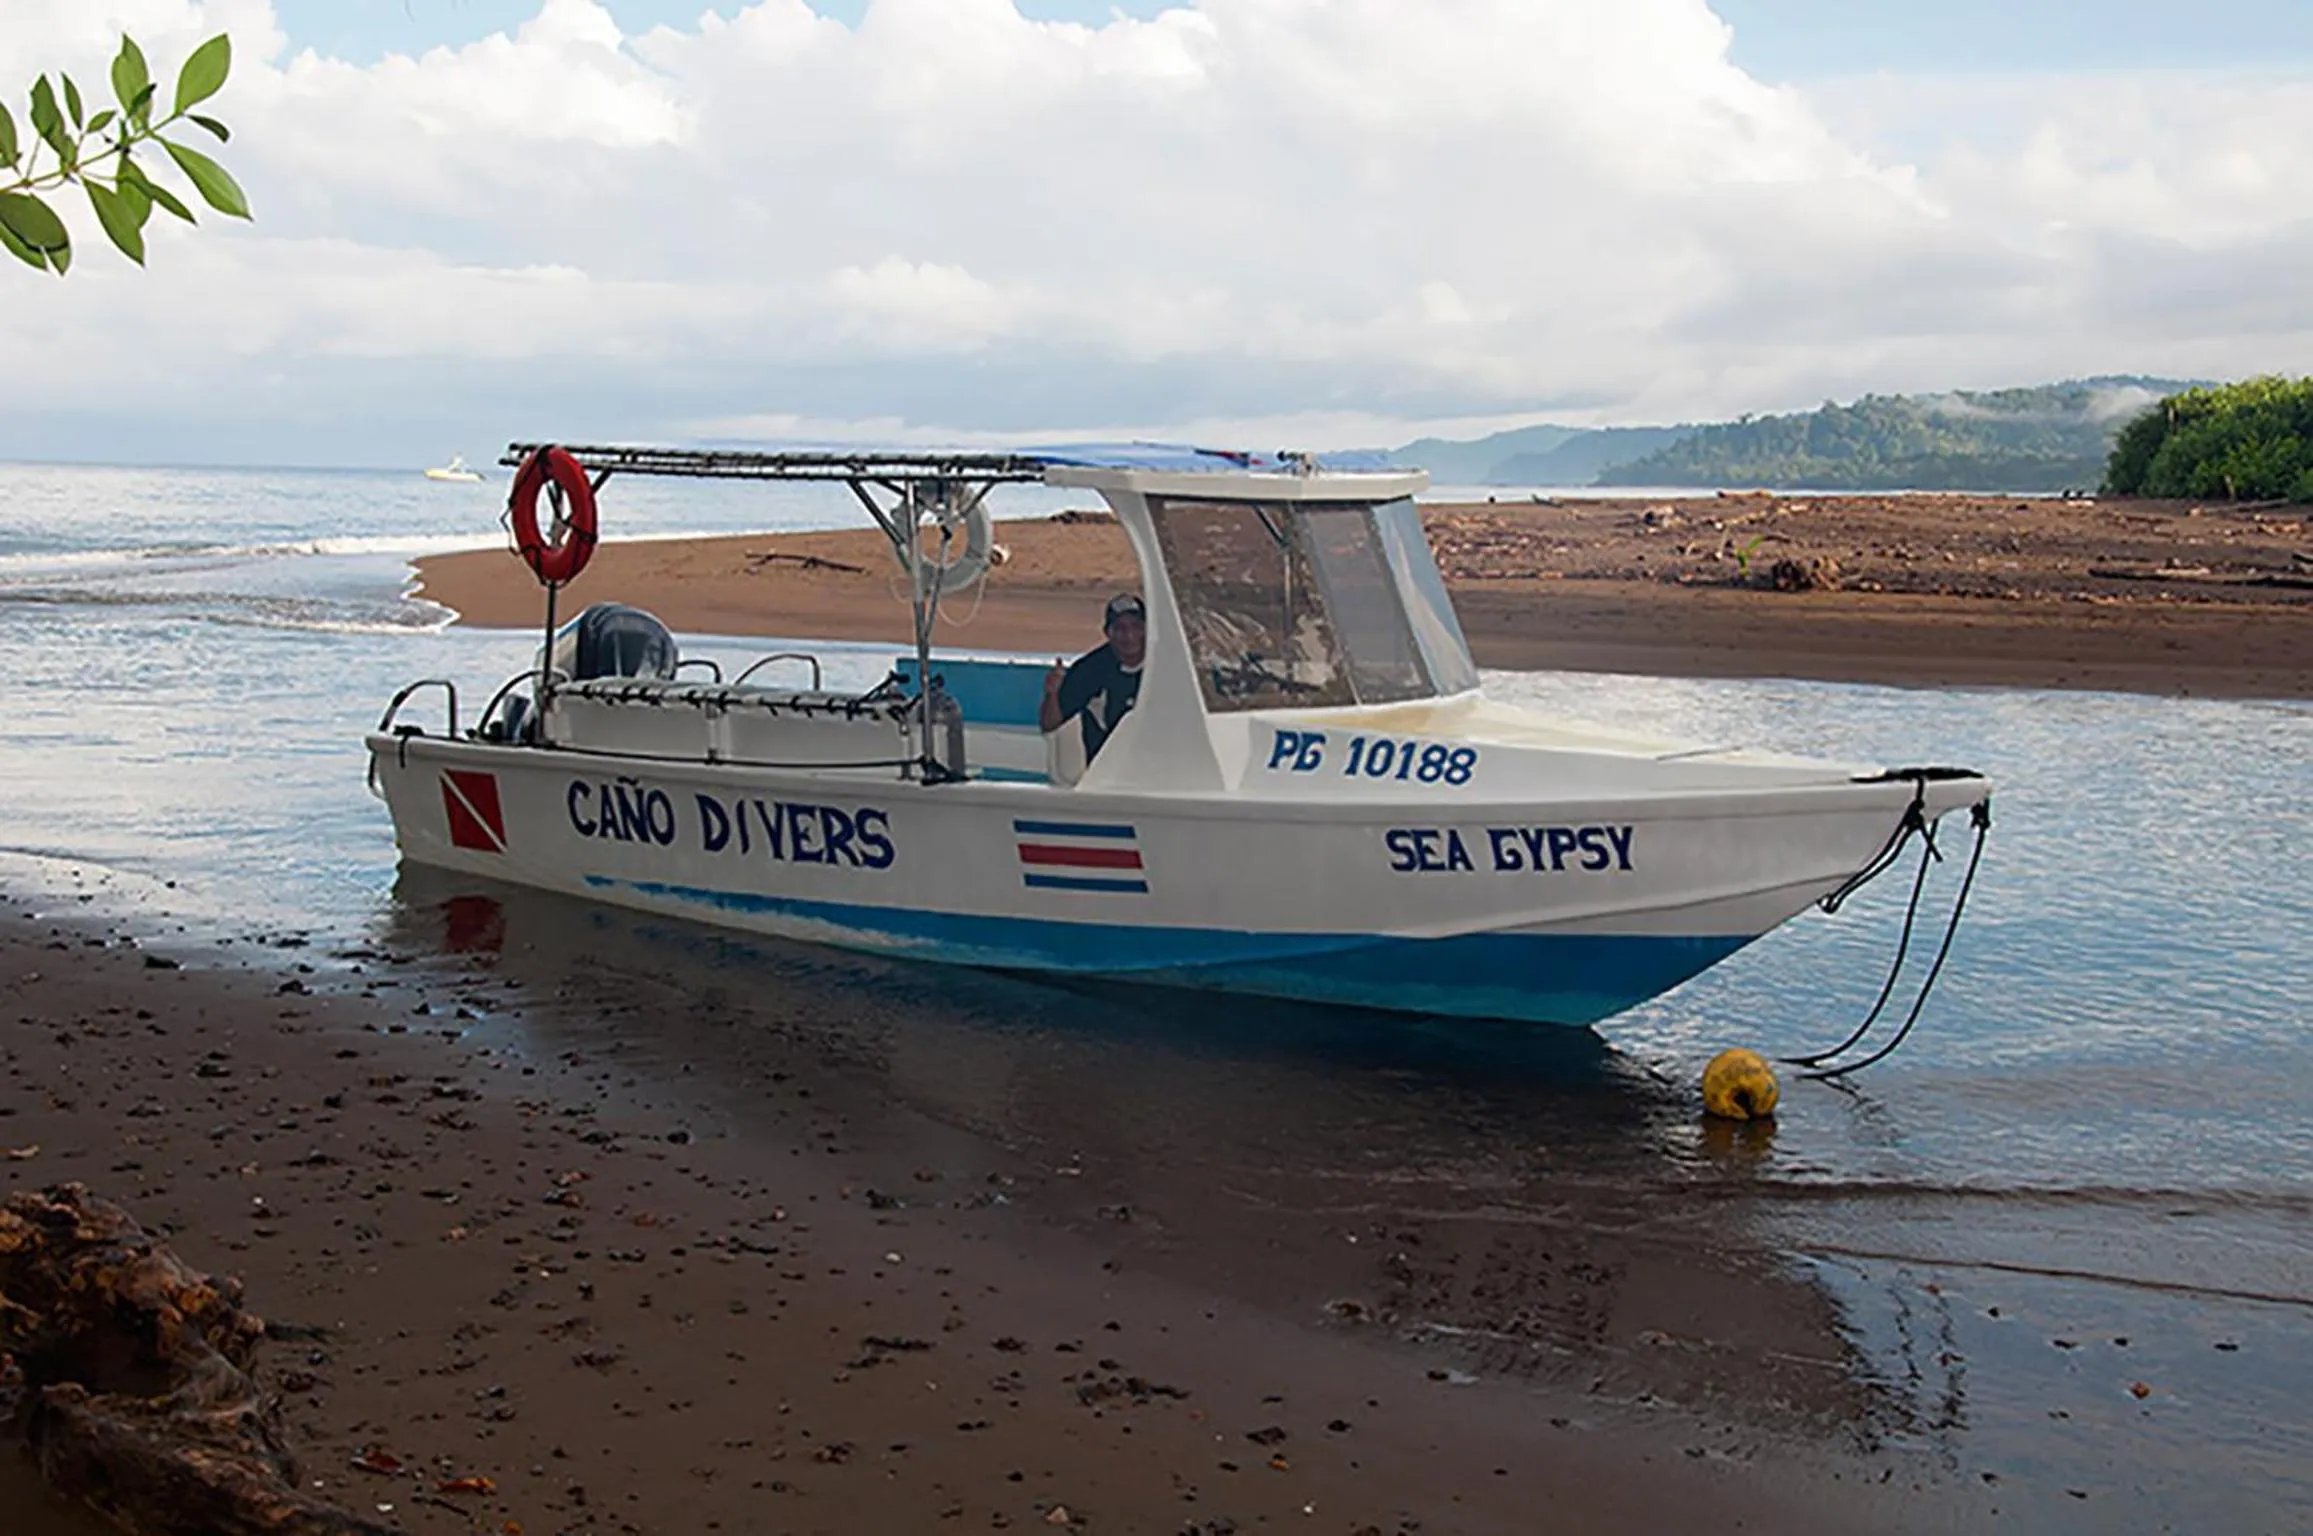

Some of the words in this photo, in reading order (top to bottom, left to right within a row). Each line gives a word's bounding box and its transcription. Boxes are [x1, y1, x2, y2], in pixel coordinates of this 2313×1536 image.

[1267, 729, 1326, 771] PG
[1344, 736, 1479, 786] 10188
[567, 776, 675, 846] CAÑO
[695, 793, 896, 870] DIVERS
[1385, 828, 1474, 872] SEA
[1487, 826, 1634, 872] GYPSY
